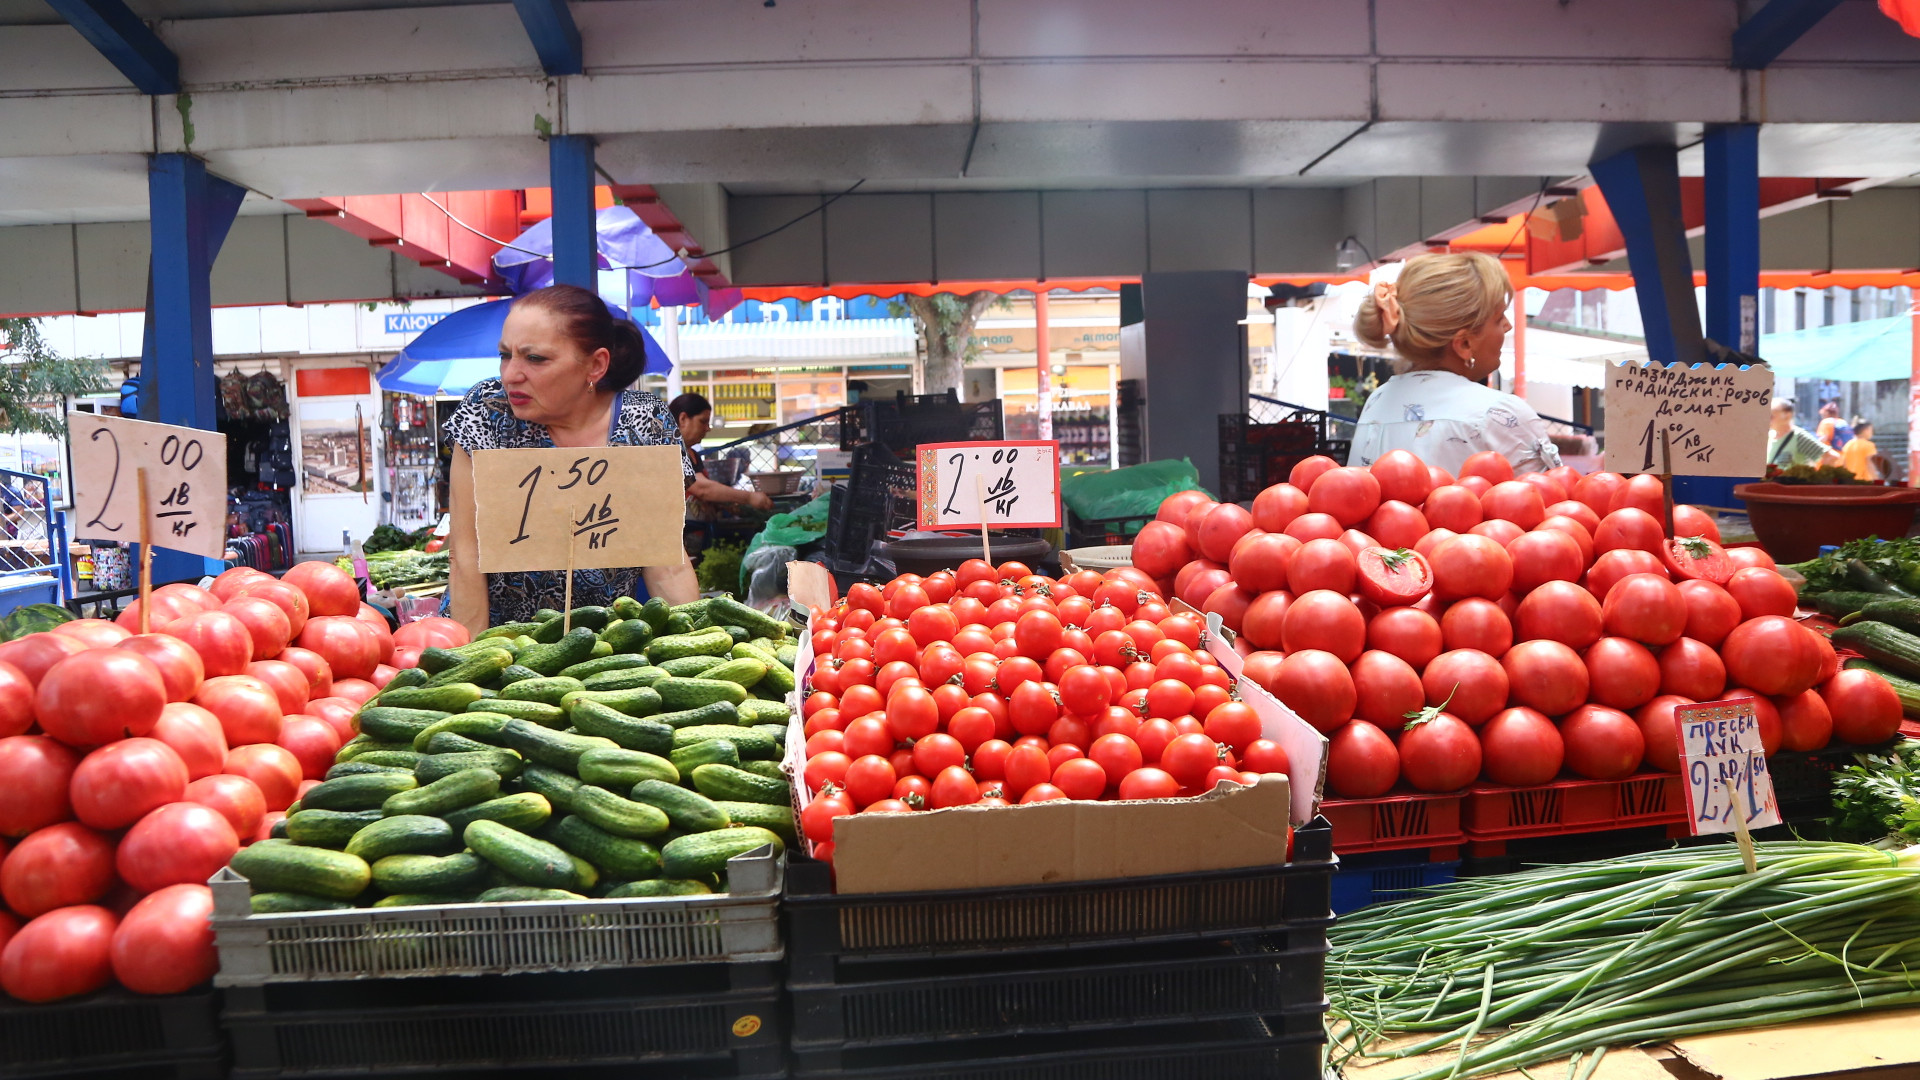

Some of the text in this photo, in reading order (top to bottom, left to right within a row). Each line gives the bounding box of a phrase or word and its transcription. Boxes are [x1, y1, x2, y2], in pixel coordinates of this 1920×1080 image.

[388, 315, 446, 331] КЛЮЧ
[1629, 365, 1735, 388] ПАЗАРДЖИК
[1026, 400, 1092, 413] КАКАВАЛ
[1655, 400, 1733, 417] ДОМАТ
[1689, 714, 1754, 741] ПРЕСЕН
[1704, 734, 1744, 757] ЛУК
